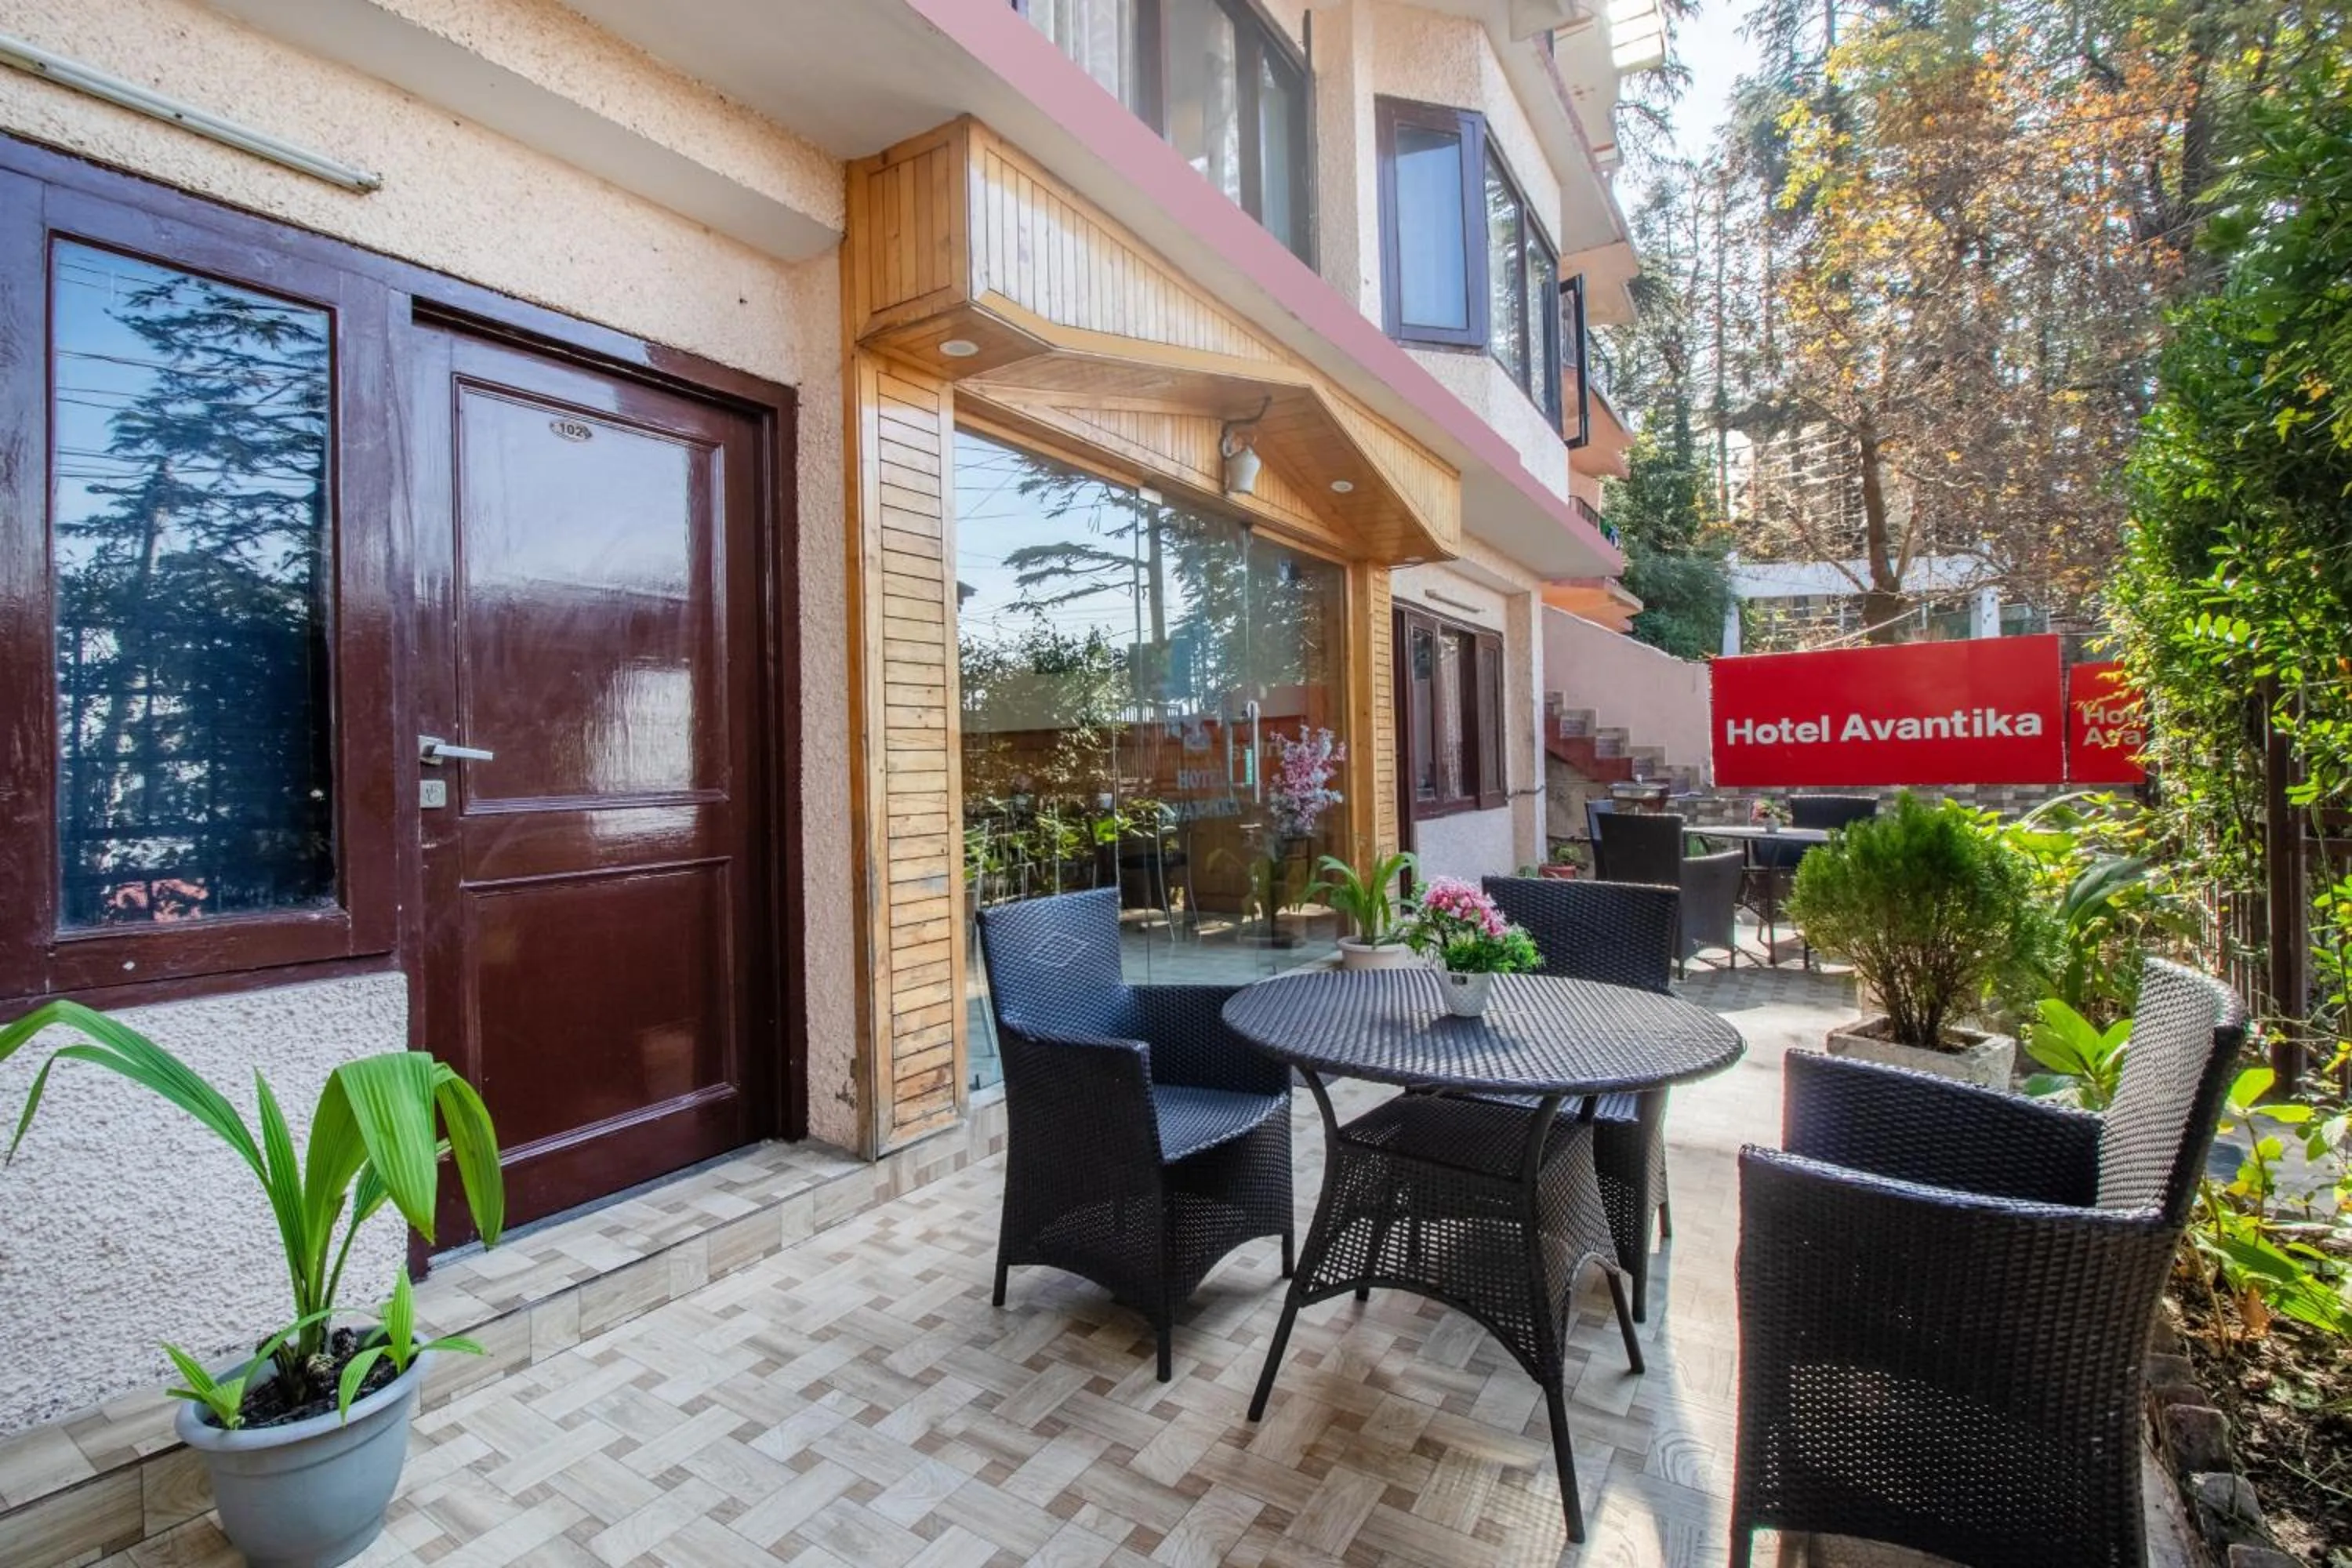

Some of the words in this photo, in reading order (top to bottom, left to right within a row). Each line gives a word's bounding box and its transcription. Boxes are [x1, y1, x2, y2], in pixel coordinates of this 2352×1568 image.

[560, 423, 584, 437] 102
[1726, 715, 1831, 746] Hotel
[1840, 708, 2042, 742] Avantika
